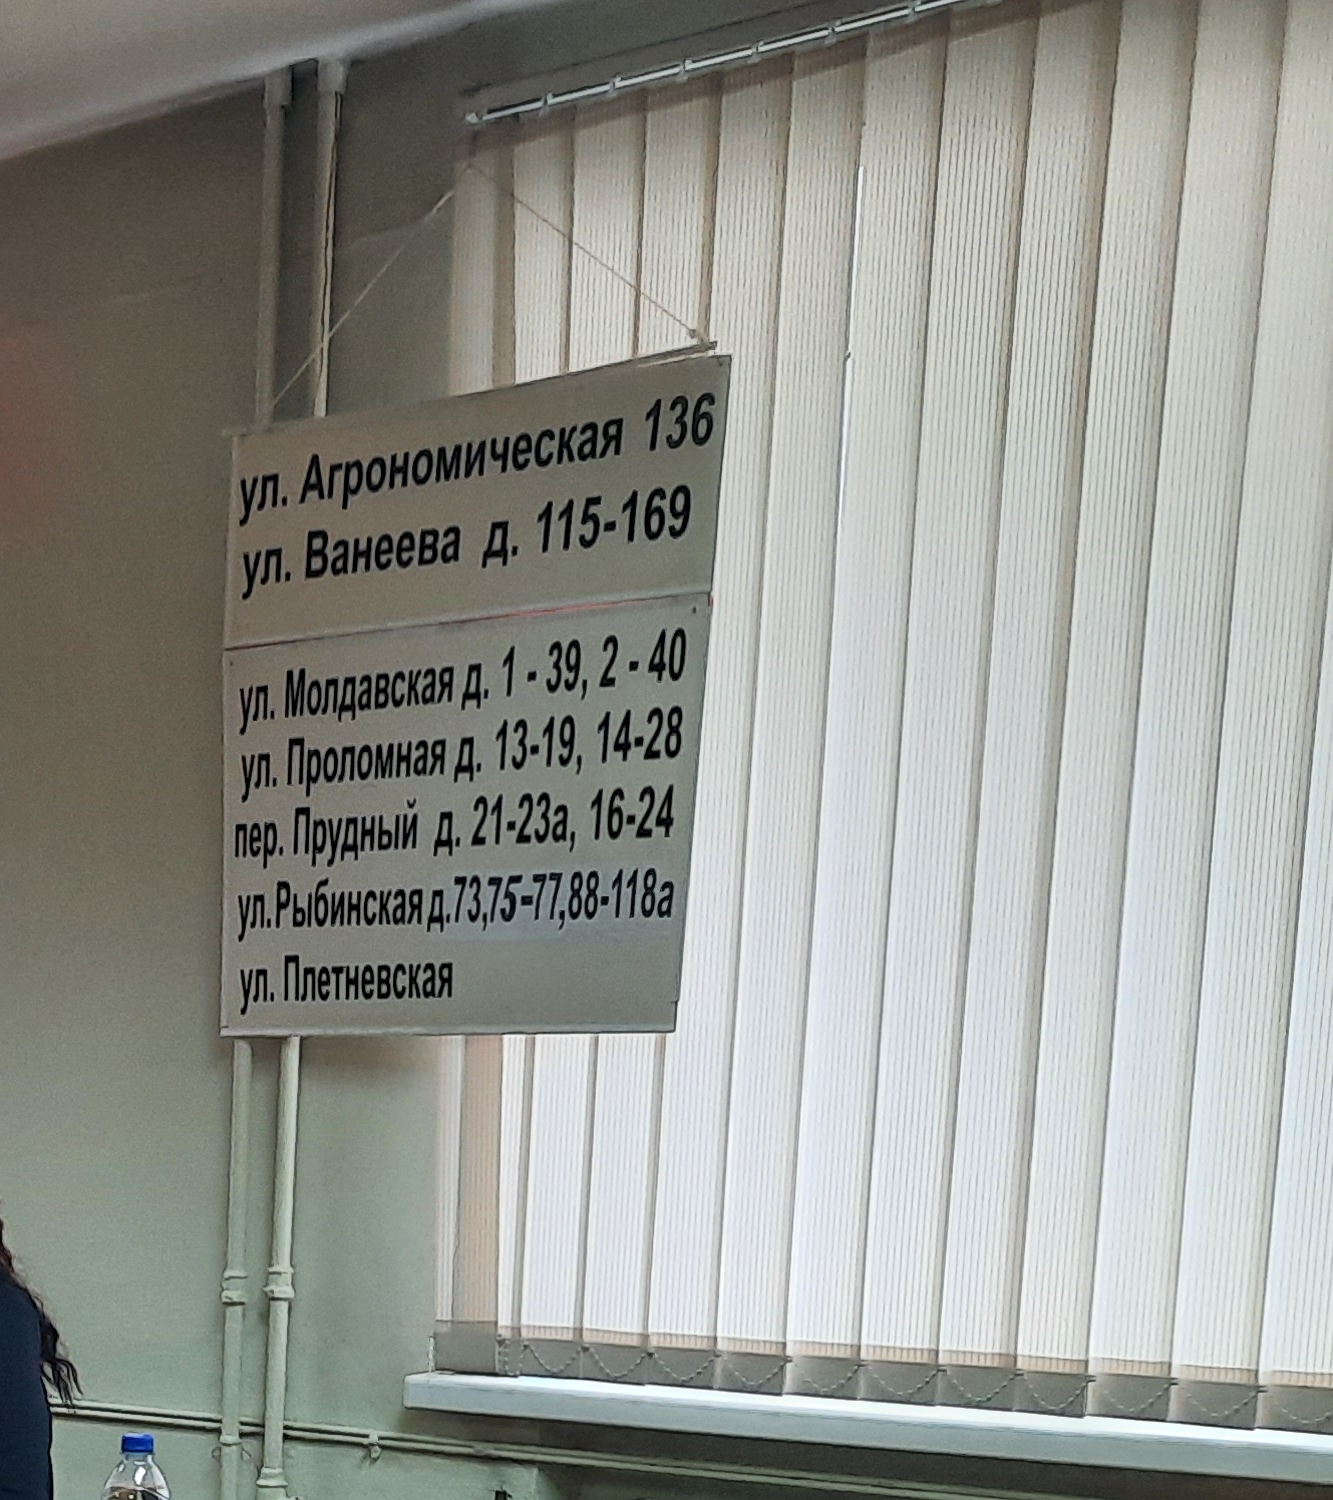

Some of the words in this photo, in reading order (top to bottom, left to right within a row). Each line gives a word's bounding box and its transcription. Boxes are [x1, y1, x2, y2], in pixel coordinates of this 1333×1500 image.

[239, 471, 287, 525] ул.
[299, 417, 623, 511] Агрономическая
[644, 392, 715, 453] 136
[242, 545, 292, 600] ул.
[305, 523, 460, 580] Ванеева
[482, 519, 519, 569] д.
[537, 484, 692, 553] 115-169
[238, 680, 275, 735] ул.
[284, 663, 454, 722] Молдавская
[461, 662, 489, 711] д.
[545, 638, 589, 700] 39,
[648, 628, 687, 683] 40
[241, 749, 278, 803] ул.
[286, 736, 446, 797] Проломная
[454, 735, 482, 782] д.
[495, 714, 583, 775] 13-19,
[597, 705, 683, 765] 14-28
[234, 818, 284, 869] пер.
[293, 801, 418, 868] Прудный
[434, 810, 461, 857] д.
[471, 792, 577, 852] 21-23а,
[590, 784, 675, 841] 16-24
[239, 966, 275, 1015] ул.
[283, 955, 453, 1002] Плетневская
